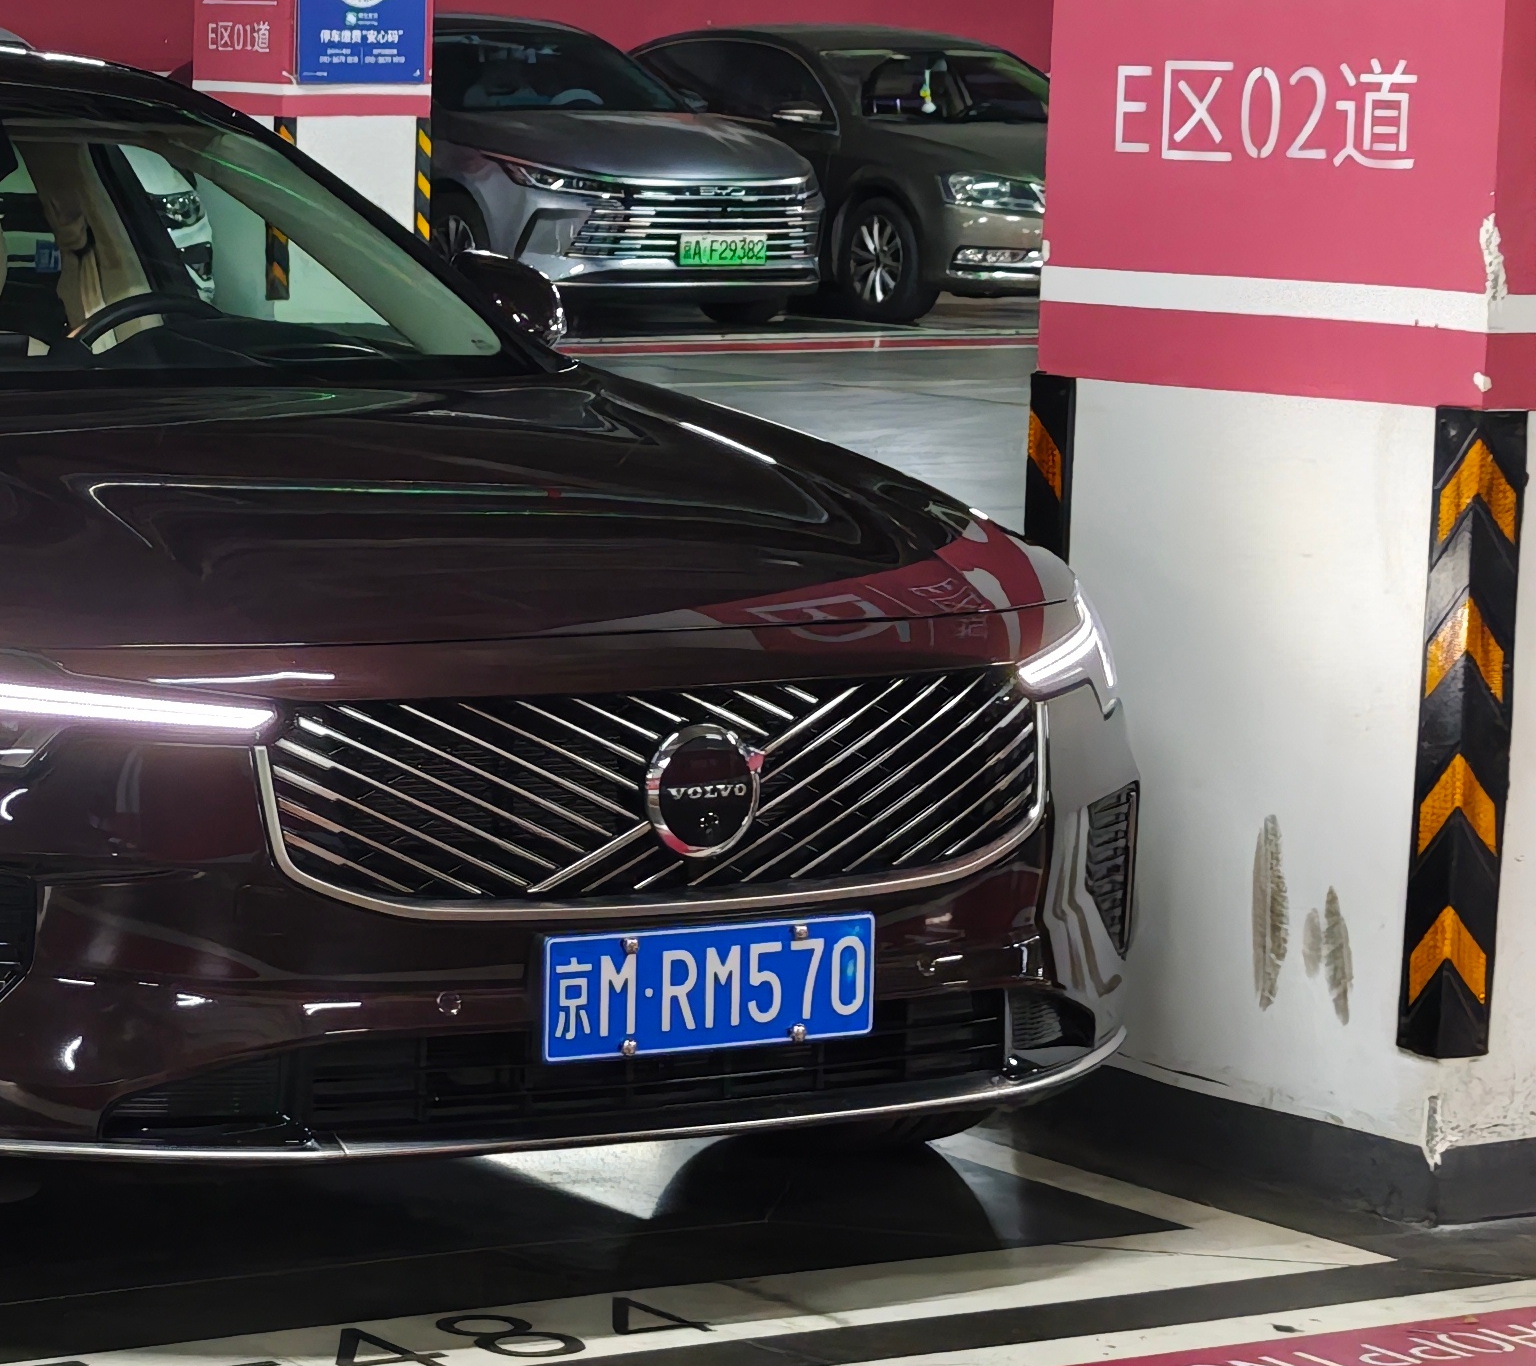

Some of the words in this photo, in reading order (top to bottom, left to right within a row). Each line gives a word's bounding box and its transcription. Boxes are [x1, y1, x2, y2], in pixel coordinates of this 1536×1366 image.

[208, 22, 270, 52] E区01道
[1115, 58, 1418, 169] E区02道
[667, 782, 747, 800] VOLVO
[555, 935, 866, 1041] 京M·RM570
